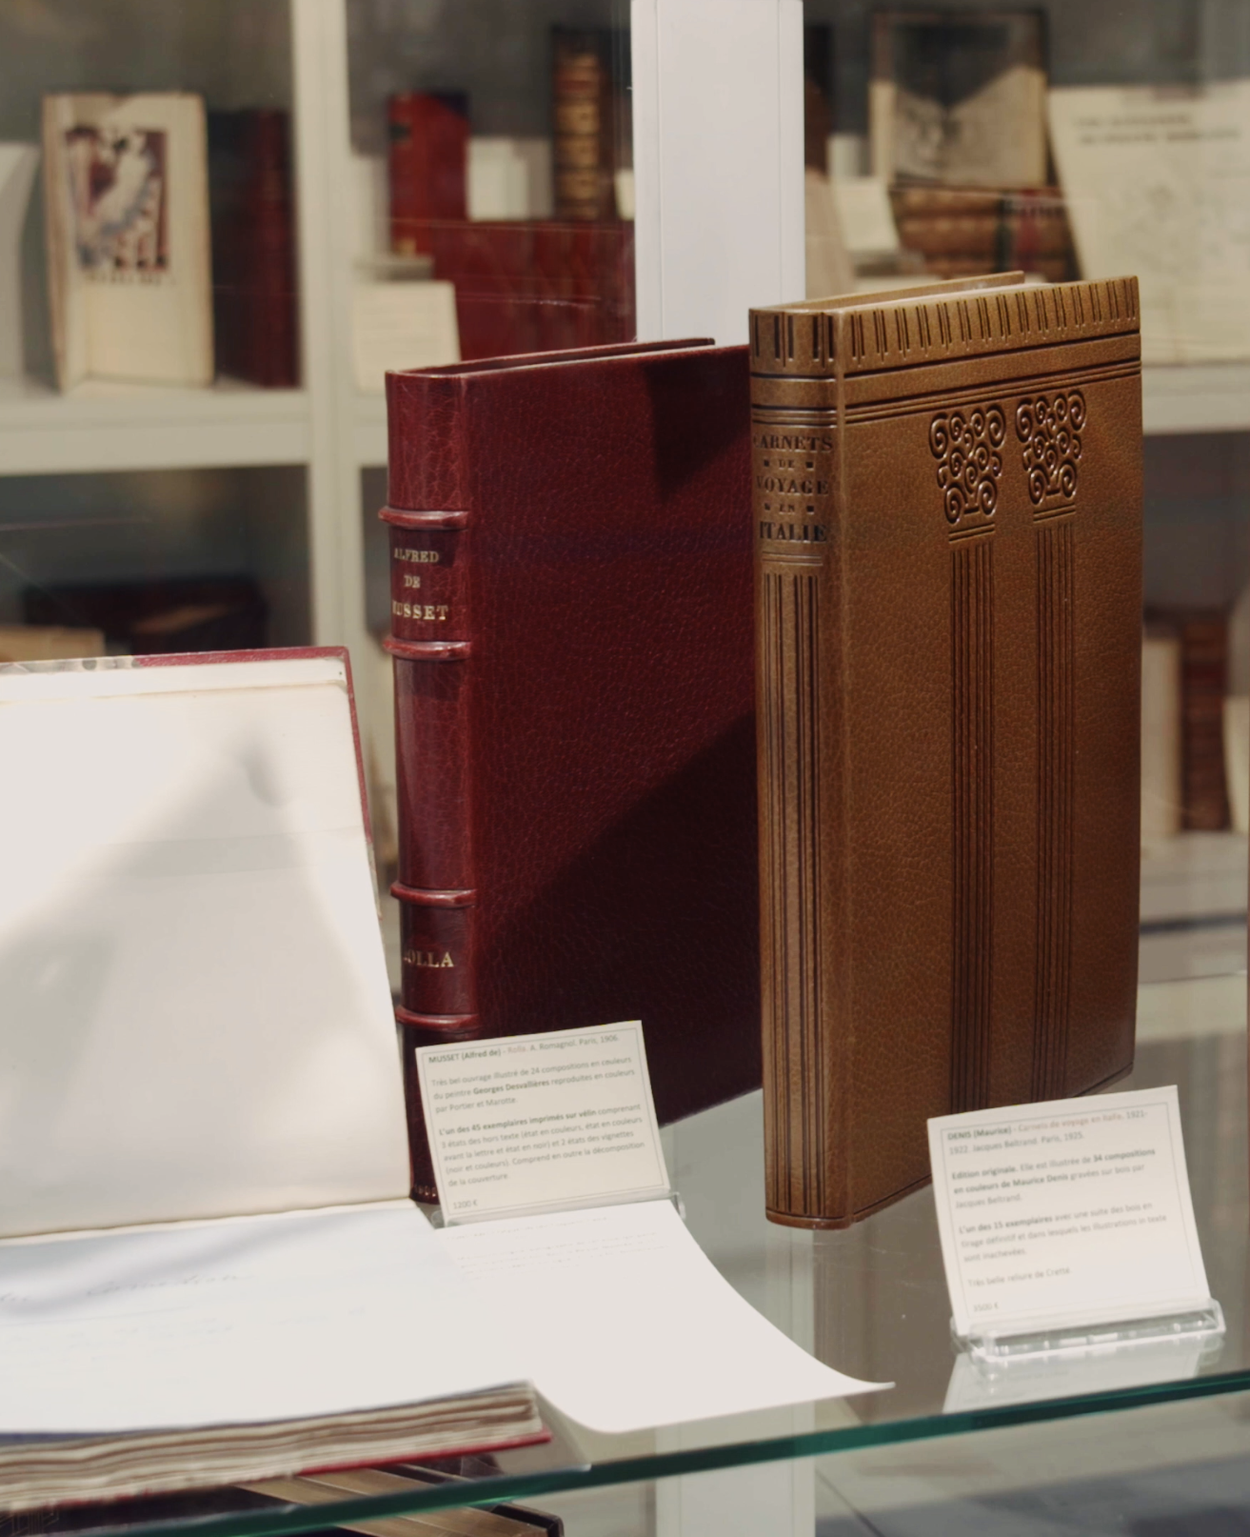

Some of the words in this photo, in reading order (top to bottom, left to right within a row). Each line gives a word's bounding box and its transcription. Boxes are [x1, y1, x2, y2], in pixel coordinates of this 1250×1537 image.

[756, 475, 829, 496] VOYAGE
[759, 521, 828, 543] ITALIE
[404, 575, 421, 588] DE
